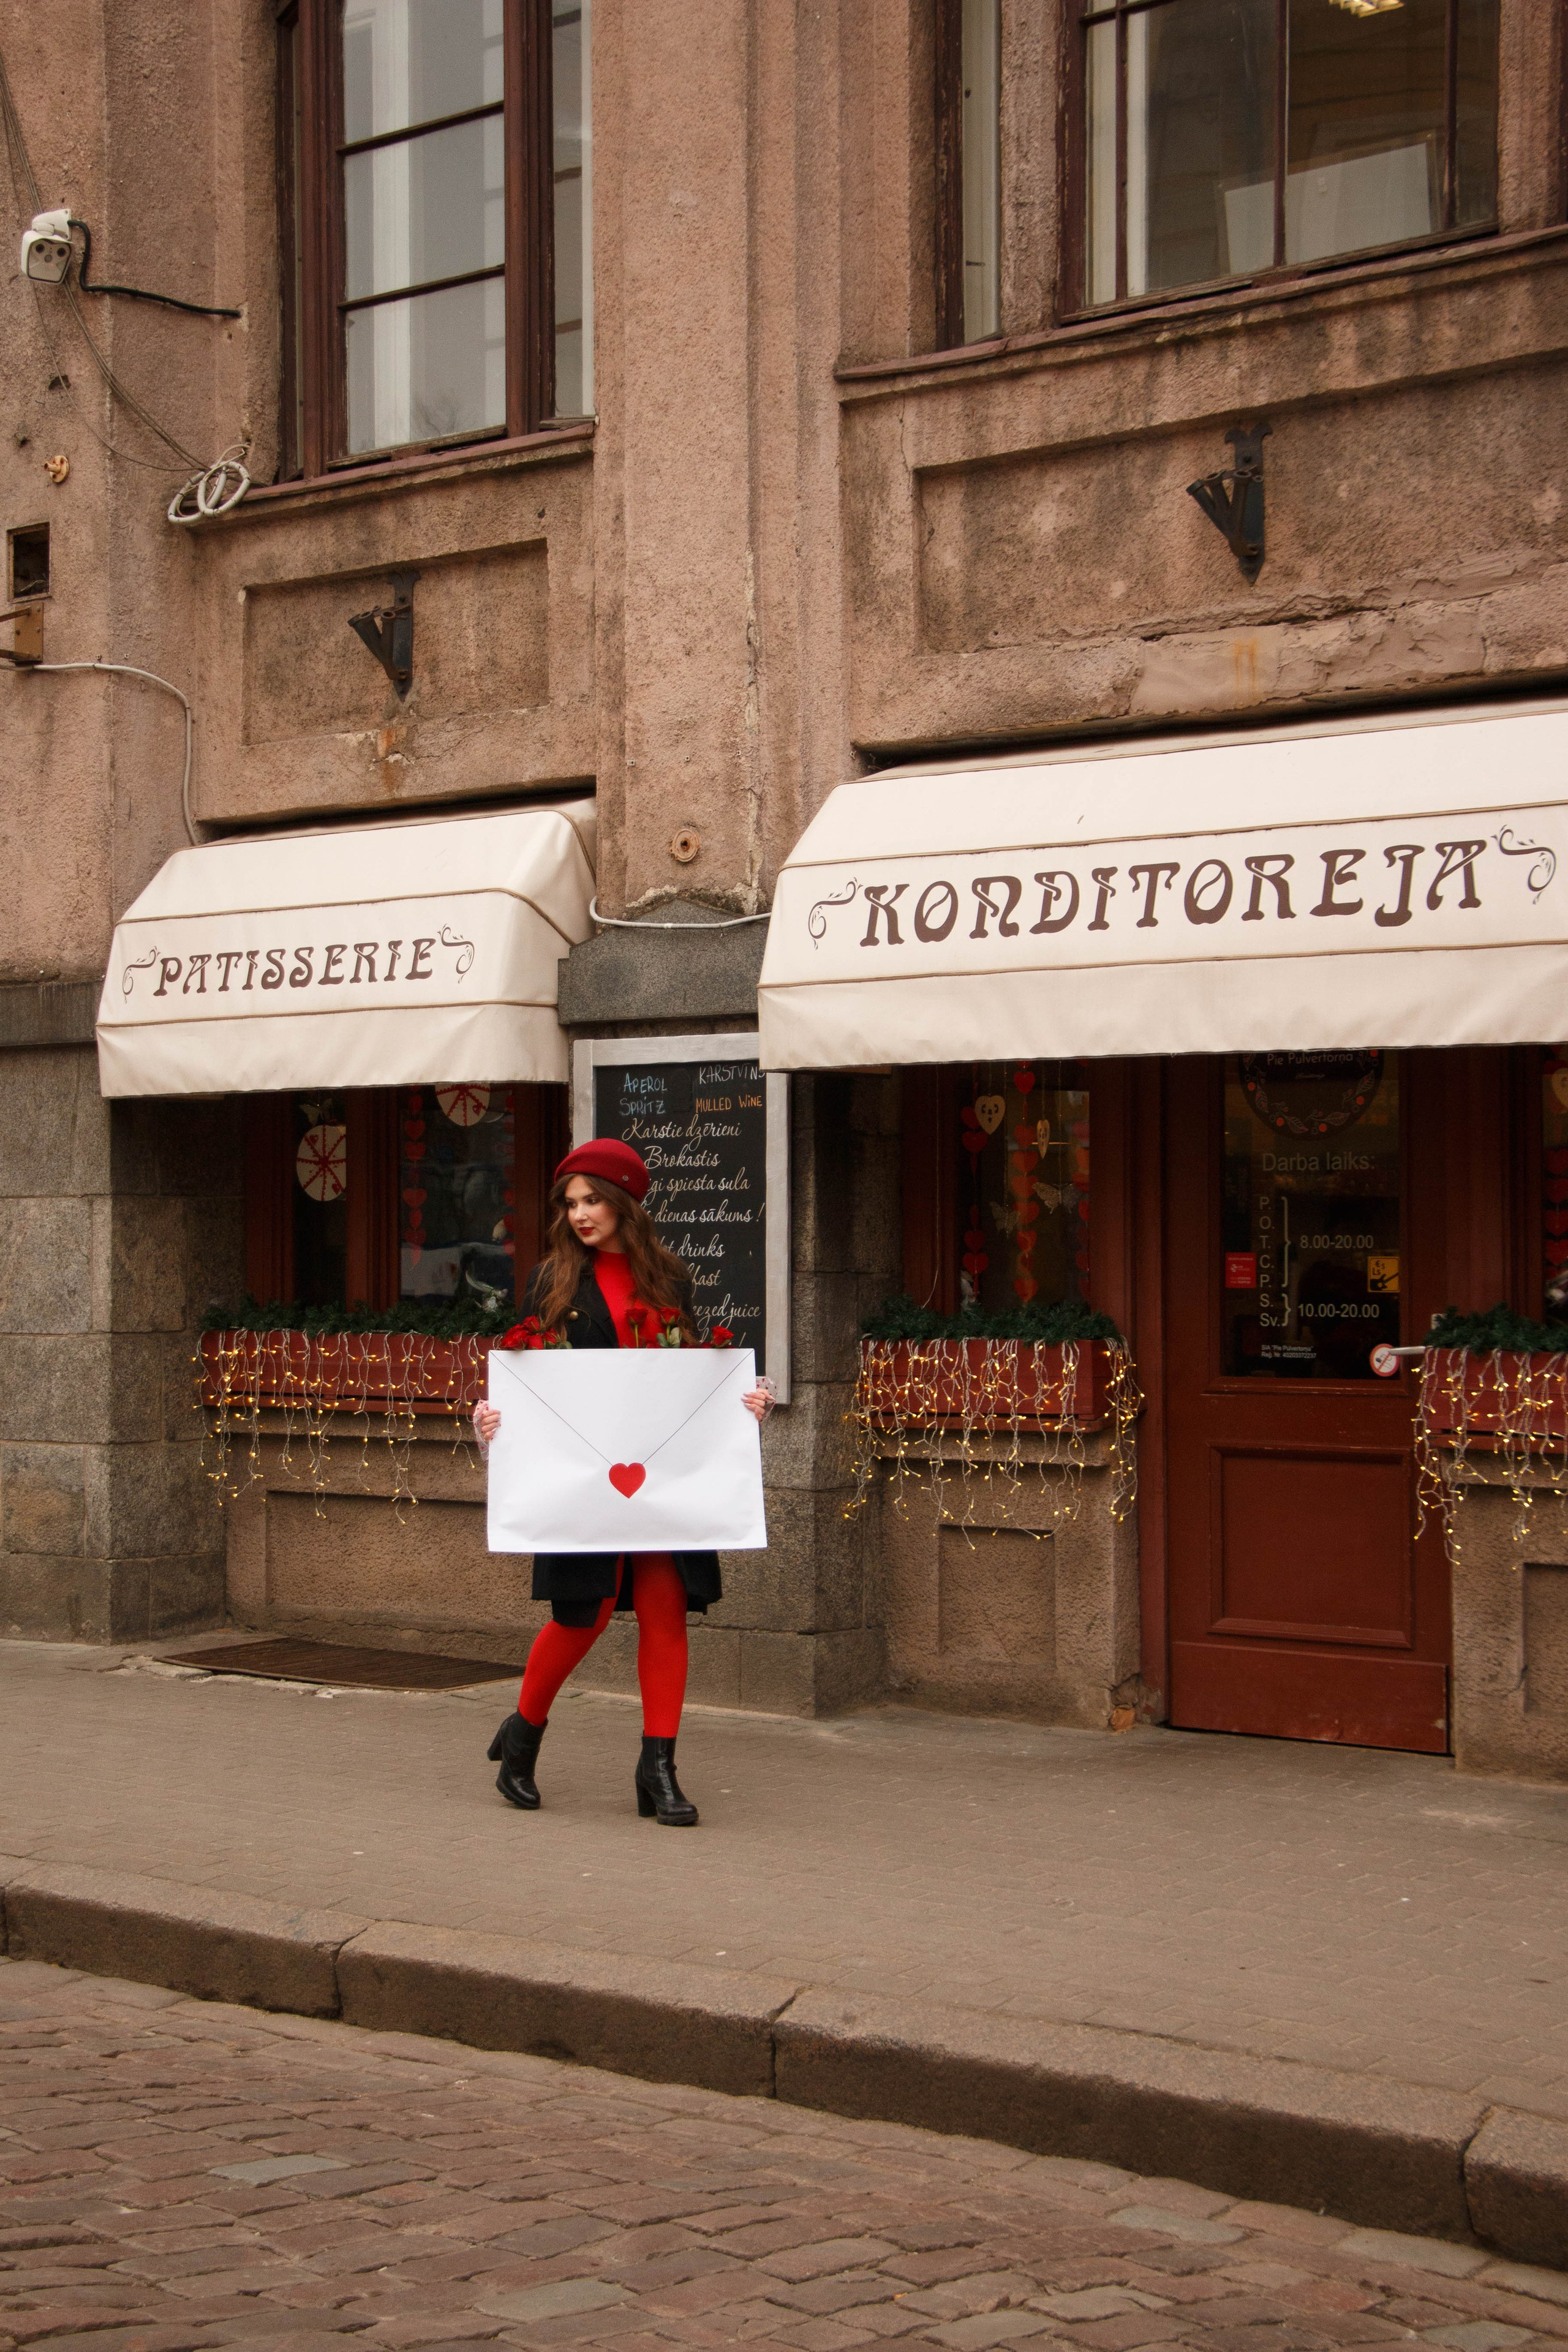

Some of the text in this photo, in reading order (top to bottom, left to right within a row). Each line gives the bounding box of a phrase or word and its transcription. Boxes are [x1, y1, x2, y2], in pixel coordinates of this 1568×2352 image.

[860, 840, 1487, 947] KONDITOREJA
[153, 938, 436, 997] PATISSERIE
[1267, 1053, 1284, 1065] Pie
[624, 1072, 668, 1093] APEROL
[695, 1096, 732, 1114] MULLED
[622, 1114, 742, 1152] Karstie dzērieni
[644, 1144, 721, 1169] Brokastis
[1263, 1151, 1376, 1171] Darba laiks:
[666, 1174, 716, 1202] spiesta
[718, 1167, 751, 1191] sula
[655, 1199, 698, 1223] dienas
[1259, 1196, 1272, 1210] P.
[1259, 1216, 1275, 1230] O.
[677, 1234, 725, 1257] drinks
[1259, 1235, 1272, 1250] T.
[1300, 1235, 1374, 1249] 8.00-20.00
[1259, 1254, 1275, 1268] C.
[1259, 1274, 1272, 1288] P.
[1259, 1293, 1274, 1307] S.
[719, 1303, 761, 1329] juice
[1298, 1303, 1380, 1317] 10.00-20.00
[1259, 1313, 1281, 1327] Sv.
